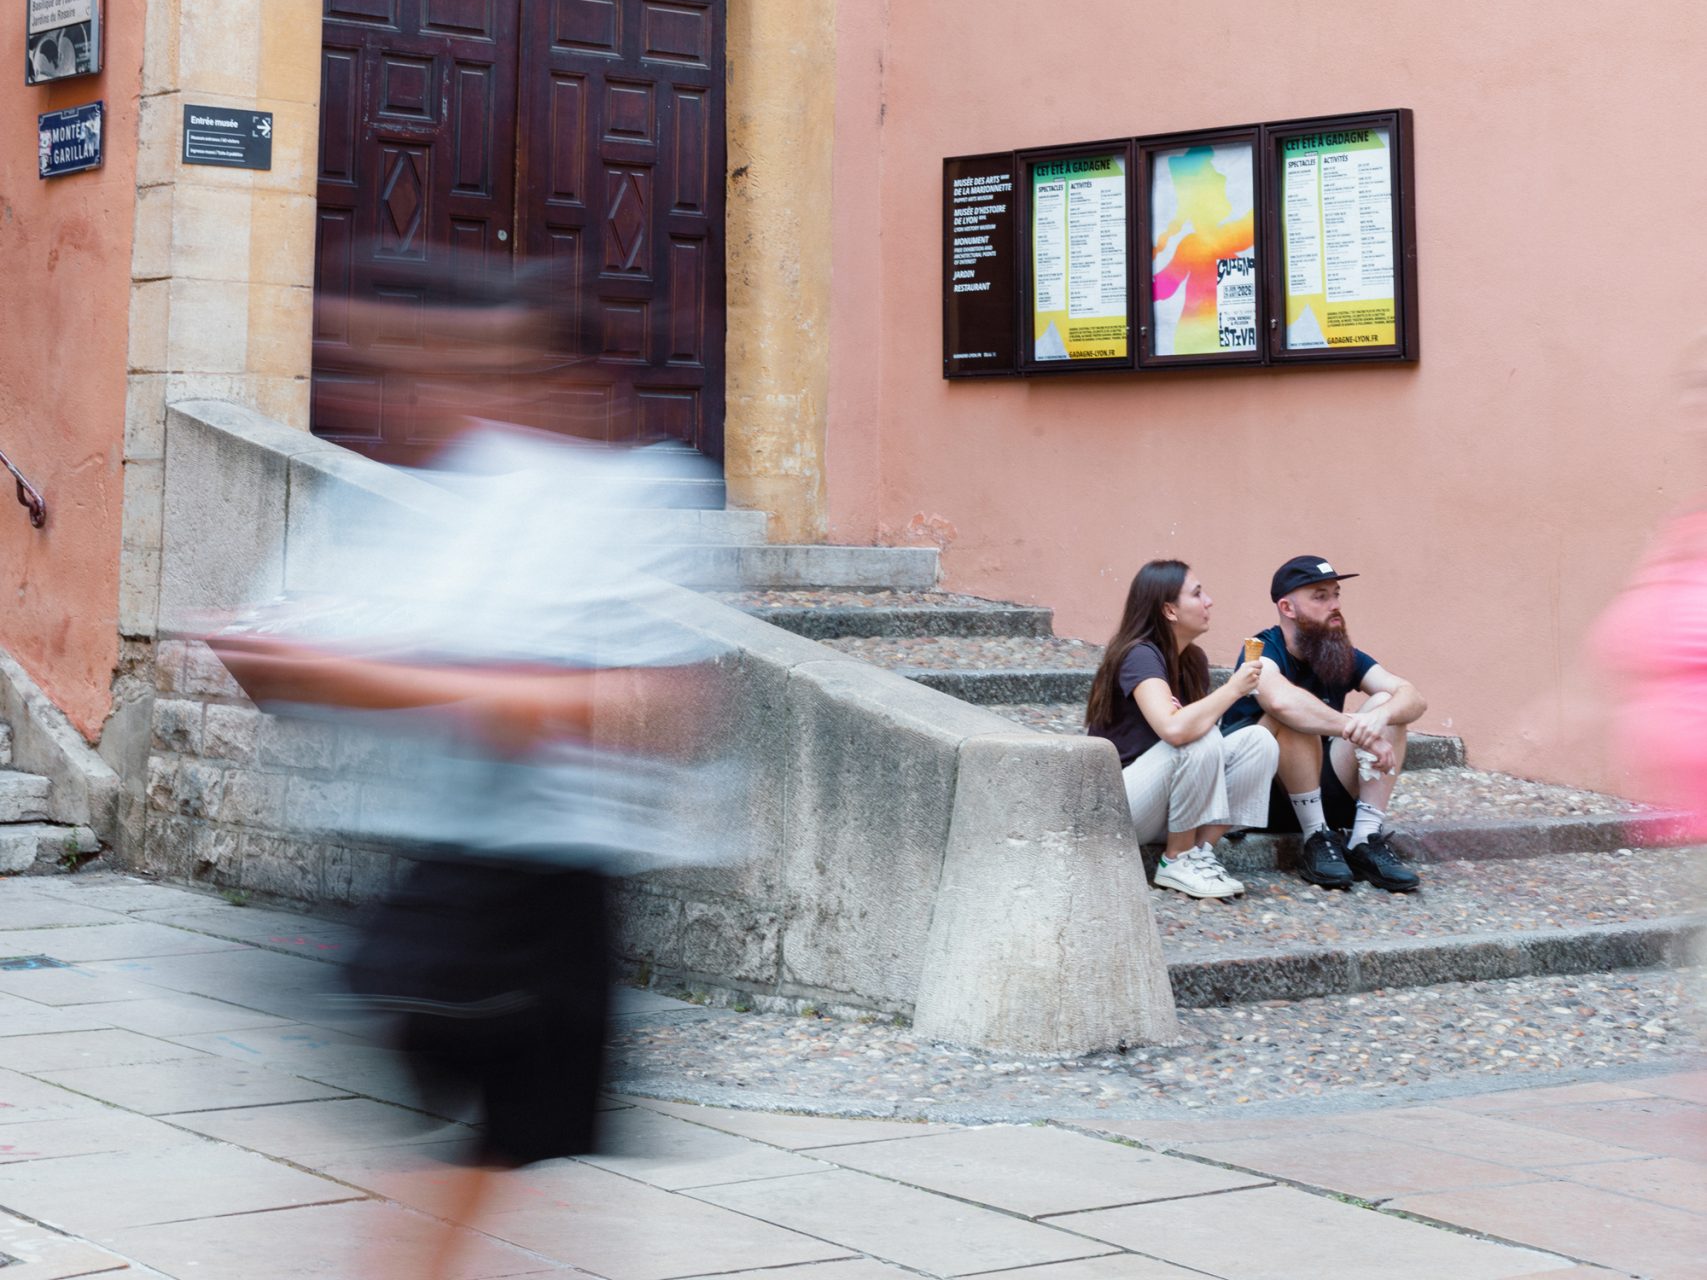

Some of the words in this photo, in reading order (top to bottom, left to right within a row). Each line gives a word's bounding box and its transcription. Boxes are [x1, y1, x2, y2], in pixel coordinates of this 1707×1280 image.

[32, 0, 54, 12] Basilique
[32, 14, 49, 26] Jardins
[50, 12, 56, 22] du
[57, 8, 75, 20] Rosaire
[190, 115, 214, 126] Entrée
[215, 118, 239, 129] musée
[1286, 139, 1300, 151] CET
[1325, 130, 1369, 146] GADAGNE
[53, 143, 95, 165] GARILLAN
[1288, 159, 1316, 168] SPECTACLES
[1323, 154, 1349, 164] ACTIVITÉS
[1036, 165, 1050, 177] CET
[1072, 159, 1111, 173] GADAGNE
[954, 177, 973, 187] MUSÉE
[974, 177, 985, 185] DES
[986, 176, 1000, 184] ARTS
[1038, 184, 1064, 193] SPECTACLES
[1070, 181, 1093, 190] ACTIVITÉS
[954, 188, 962, 196] DE
[962, 187, 970, 195] LA
[971, 182, 1012, 195] MARIONNETTE
[954, 206, 973, 216] MUSÉE
[954, 217, 962, 225] DE
[962, 216, 978, 224] LYON
[954, 235, 990, 246] MONUMENT
[952, 270, 975, 281] JARDIN
[1217, 257, 1255, 285] GUIGNO
[954, 282, 991, 293] RESTAURANT
[1327, 334, 1379, 344] GADAGNE-LYON.FR
[1069, 349, 1115, 358] GADAGNE-LYON.FR
